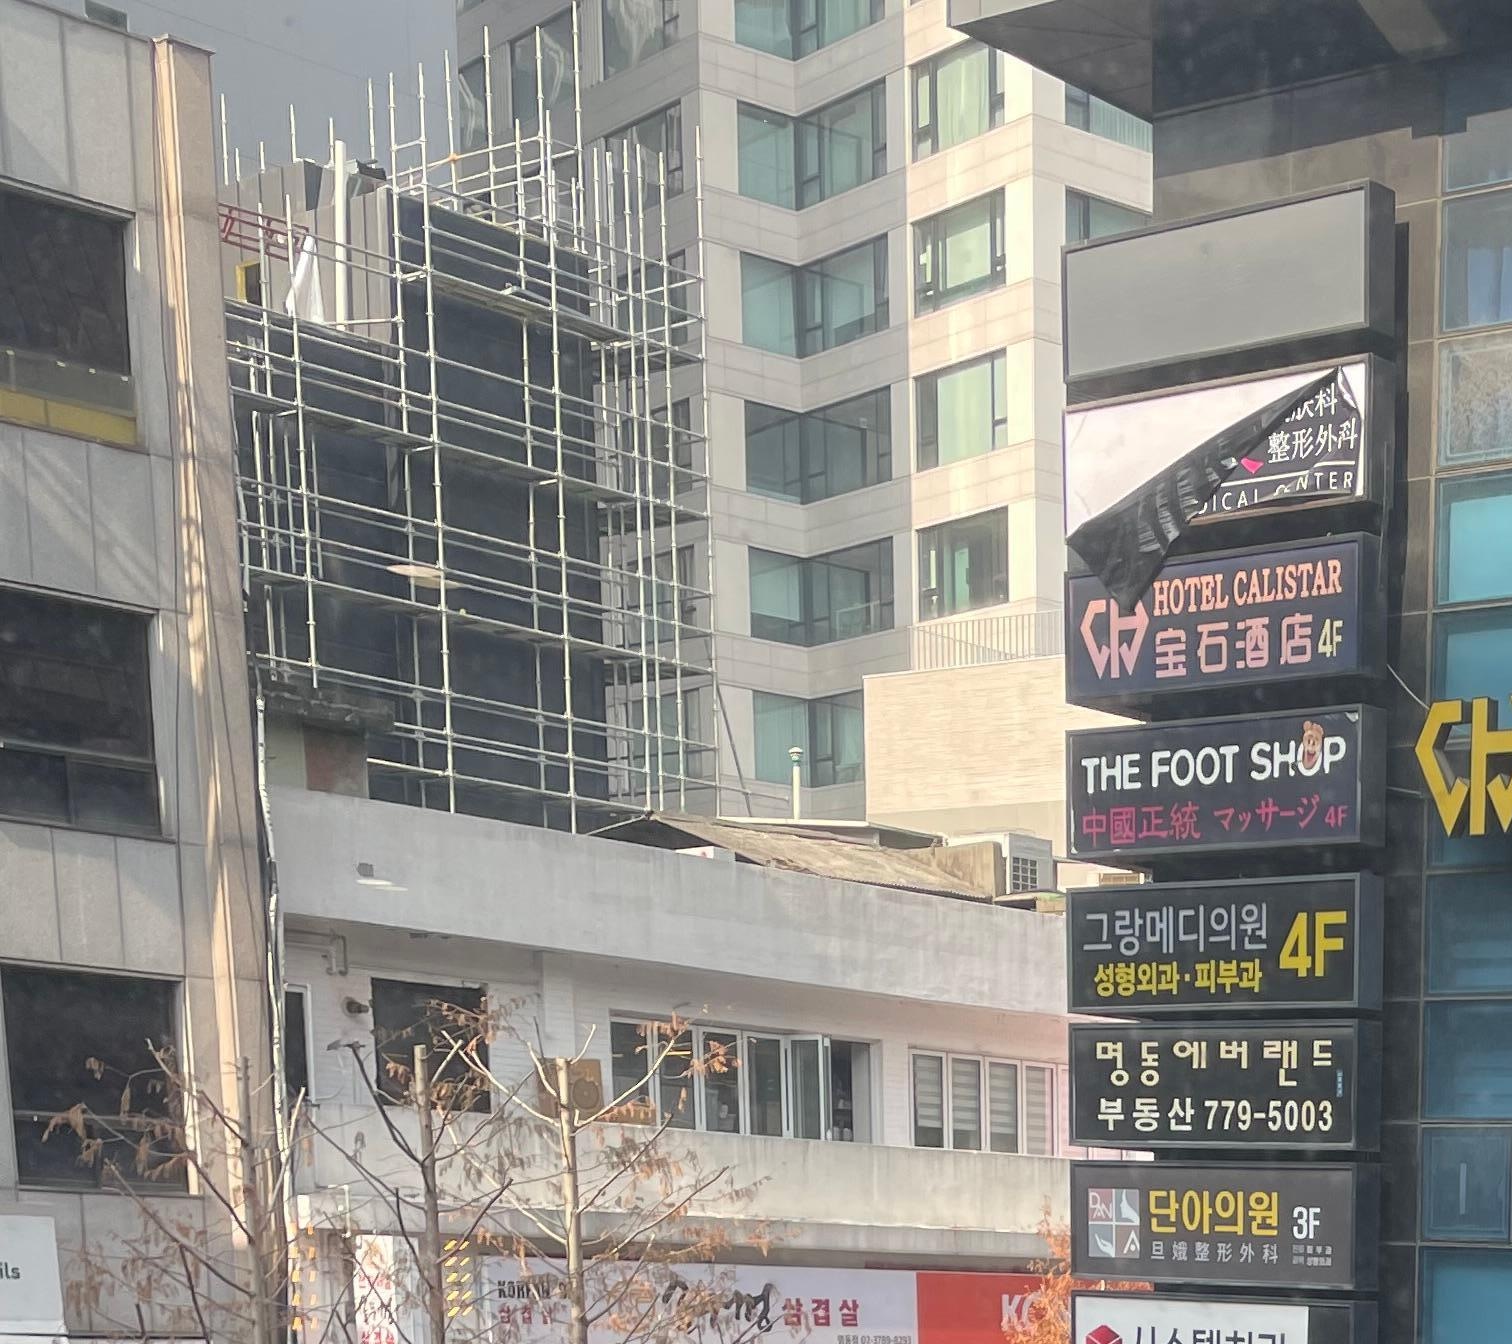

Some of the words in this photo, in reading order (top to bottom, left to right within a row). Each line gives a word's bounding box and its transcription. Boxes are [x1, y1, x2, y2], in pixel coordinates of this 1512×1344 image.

[1268, 417, 1358, 463] 整形外科
[1152, 574, 1229, 617] HOTEL
[1234, 558, 1342, 605] CALISTAR
[1155, 613, 1313, 678] 宝石酒店
[1317, 618, 1343, 659] 4F
[1082, 753, 1142, 794] THE
[1150, 744, 1240, 789] FOOT
[1250, 734, 1346, 782] SHOP
[1082, 802, 1200, 852] 中國正統
[1214, 794, 1320, 834] マッサージ
[1324, 806, 1350, 831] 4F
[1083, 902, 1268, 956] 그랑메디의원
[1279, 910, 1347, 977] 4F
[1098, 1097, 1195, 1132] 부동산
[1204, 1100, 1332, 1132] 779-5003
[1149, 1189, 1279, 1236] 단아의원
[1292, 1206, 1321, 1239] 3F
[781, 1297, 859, 1327] 삼겹살
